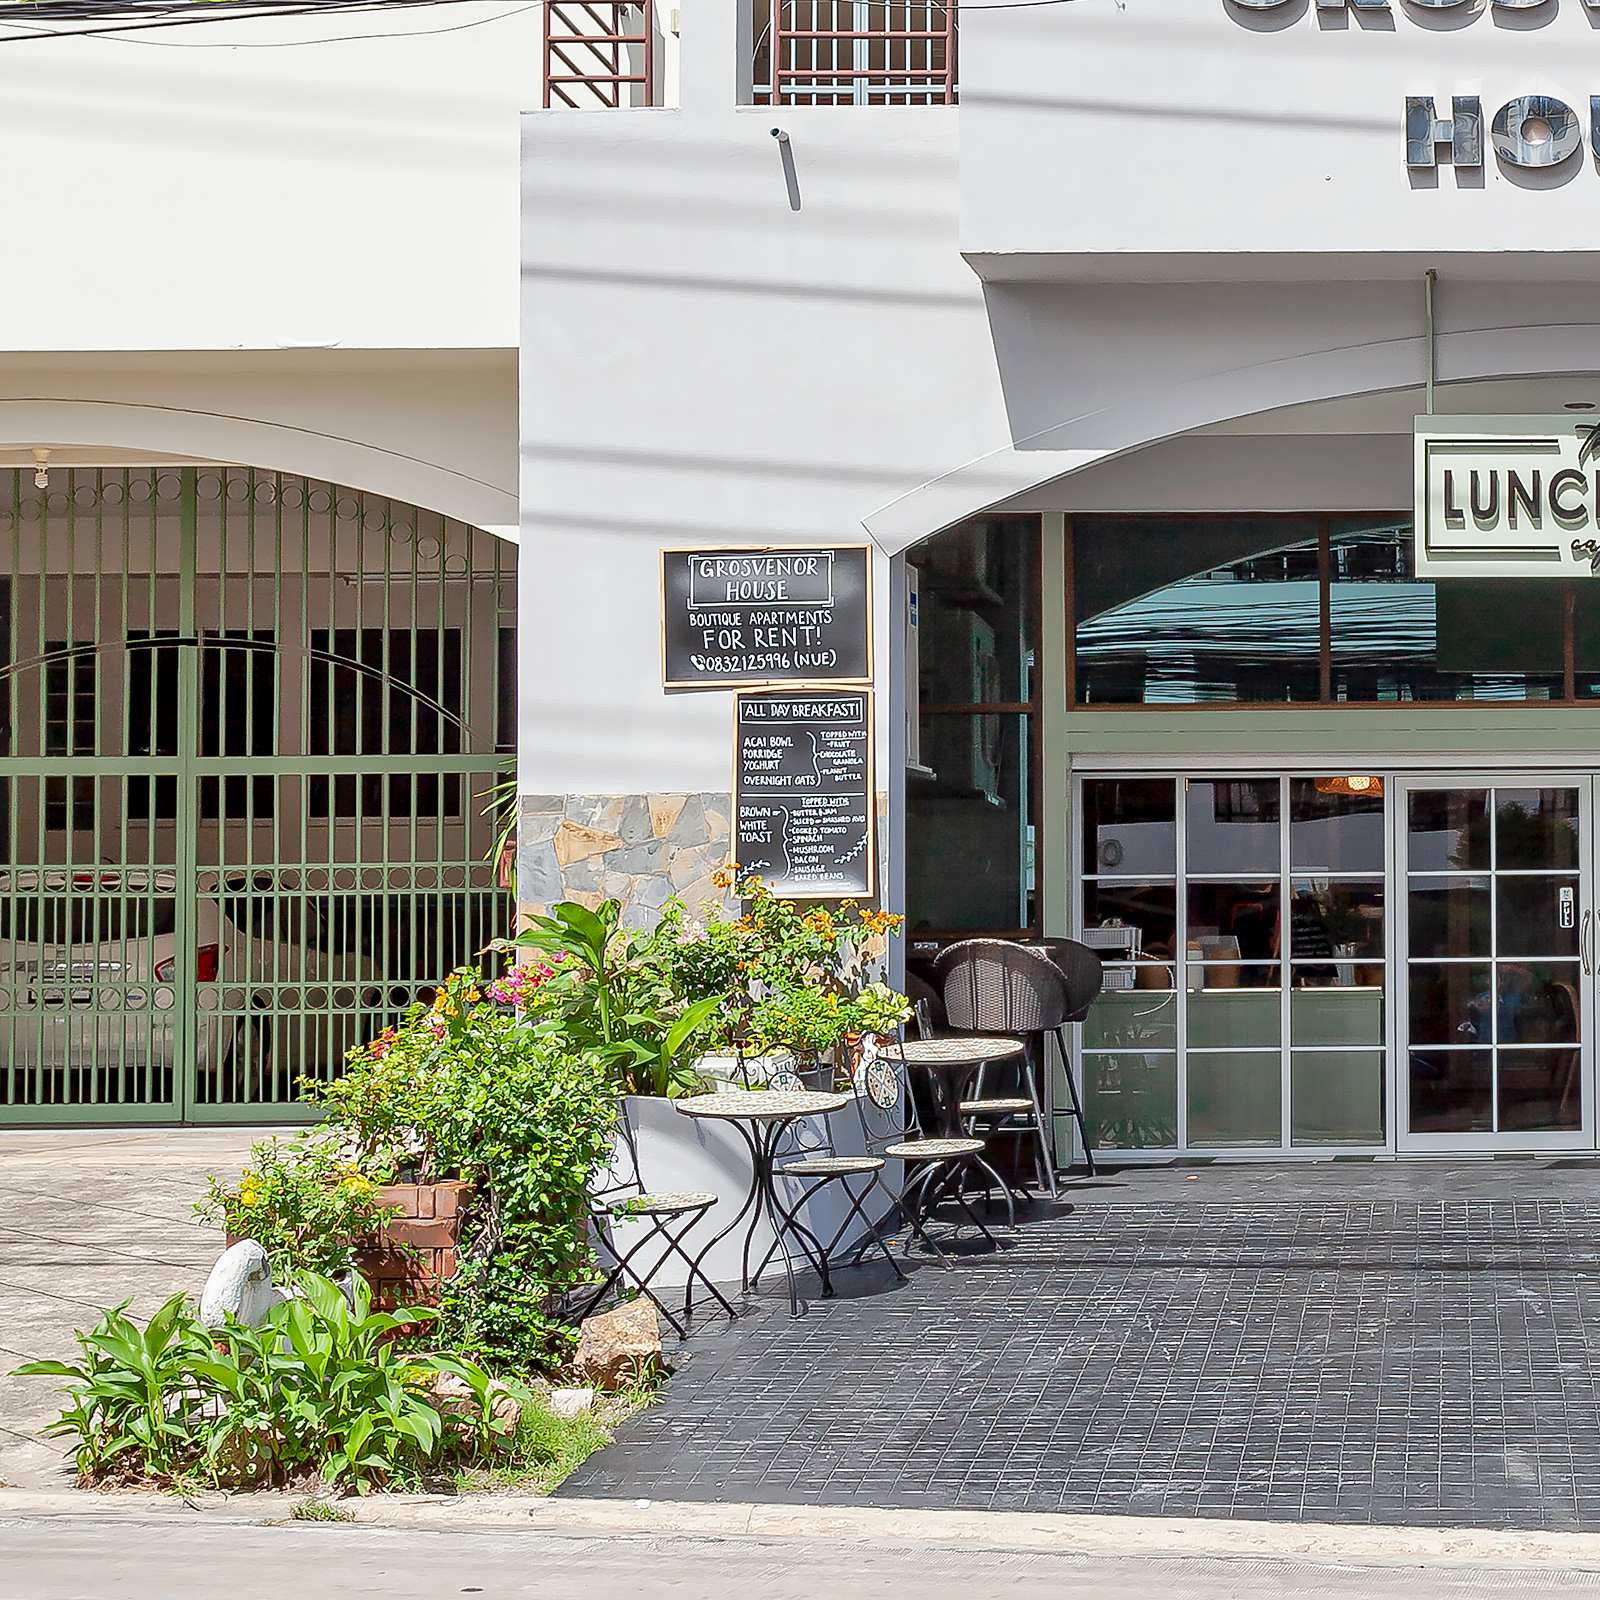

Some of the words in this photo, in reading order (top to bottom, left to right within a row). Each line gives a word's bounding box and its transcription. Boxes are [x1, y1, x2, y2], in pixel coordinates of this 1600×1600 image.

[700, 557, 819, 578] GROSVENOR
[725, 580, 789, 601] HOUSE
[689, 612, 742, 627] BOUTIQUE
[749, 610, 833, 625] APARTMENTS
[702, 629, 746, 650] FOR
[754, 626, 822, 648] RENT!
[705, 652, 791, 673] 0832125996
[793, 649, 838, 669] (NUE)
[745, 703, 766, 717] ALL
[771, 703, 790, 717] DAY
[848, 730, 867, 738] WITH
[744, 737, 766, 748] ACAI
[769, 736, 794, 748] BOWL
[742, 749, 783, 759] PORRIDGE
[743, 760, 780, 771] YOGHURT
[743, 775, 792, 786] OVERNIGHT
[794, 775, 816, 786] OATS
[739, 806, 771, 817] BROWN
[739, 820, 768, 831] WHITE
[739, 831, 773, 843] TOAST
